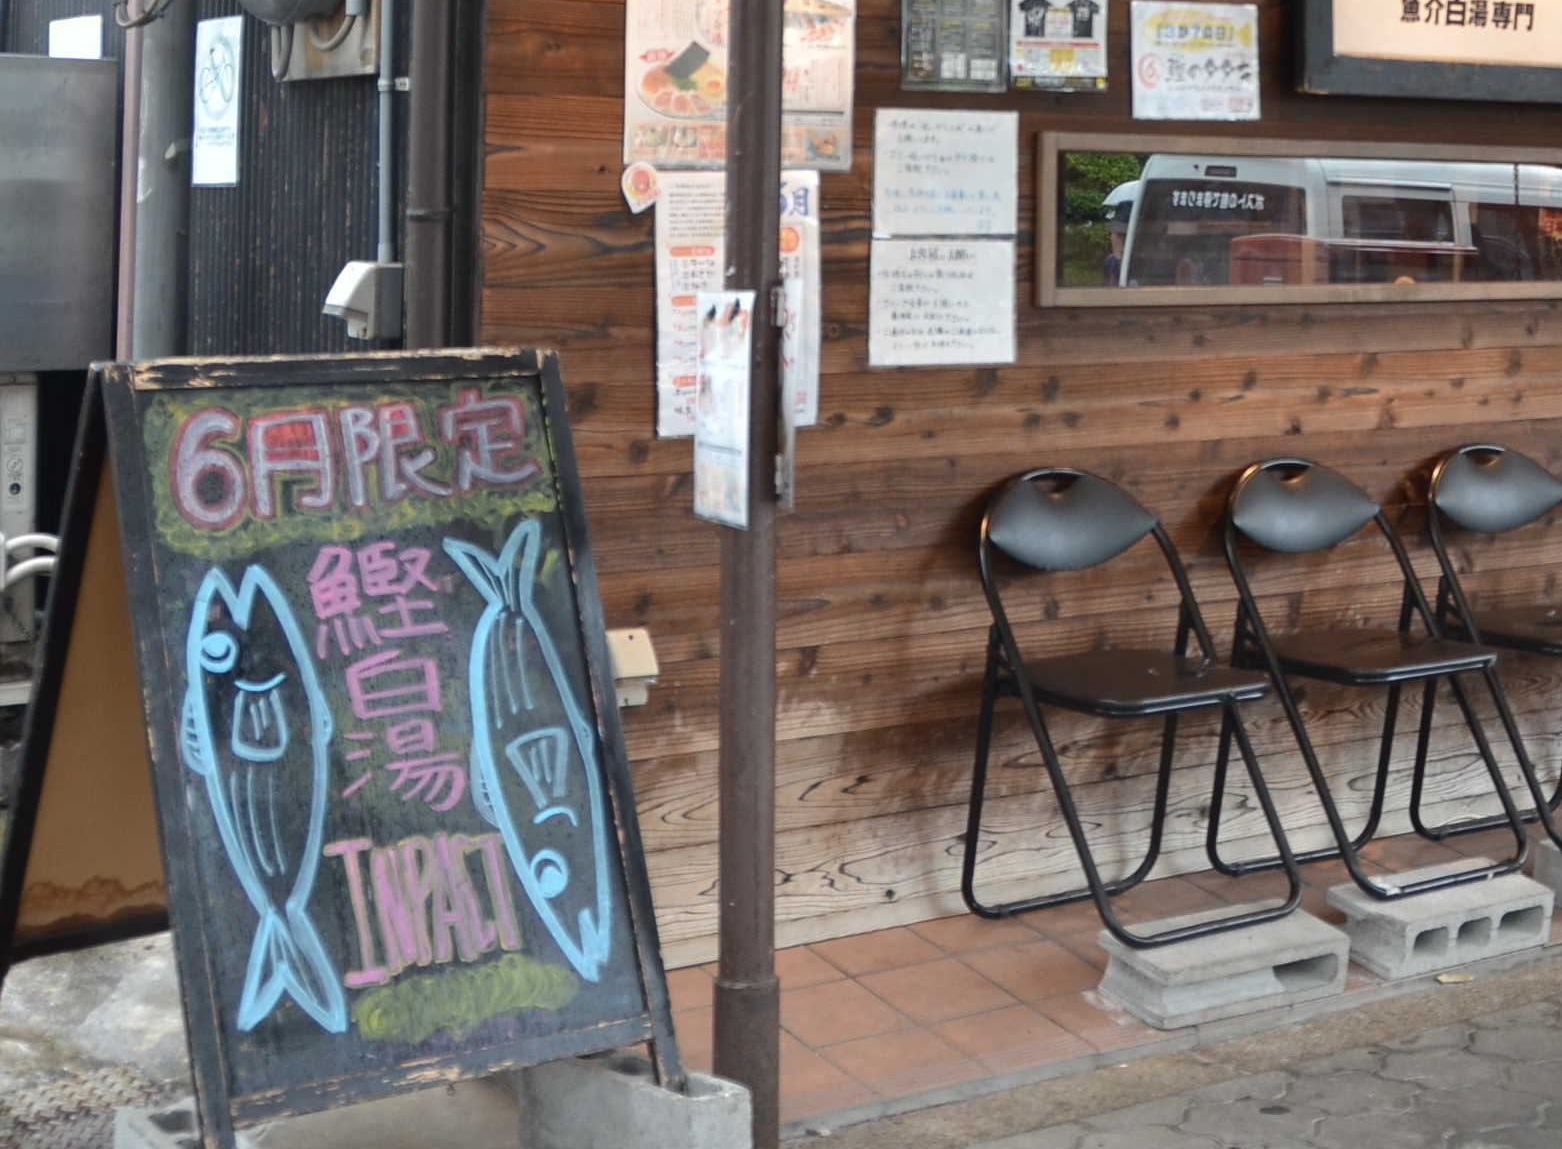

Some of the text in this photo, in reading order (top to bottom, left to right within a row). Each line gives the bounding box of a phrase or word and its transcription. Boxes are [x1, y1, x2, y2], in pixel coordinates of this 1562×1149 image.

[170, 388, 545, 529] 6月限定
[308, 539, 465, 812] 鰹白湯
[323, 831, 523, 988] INPACT
